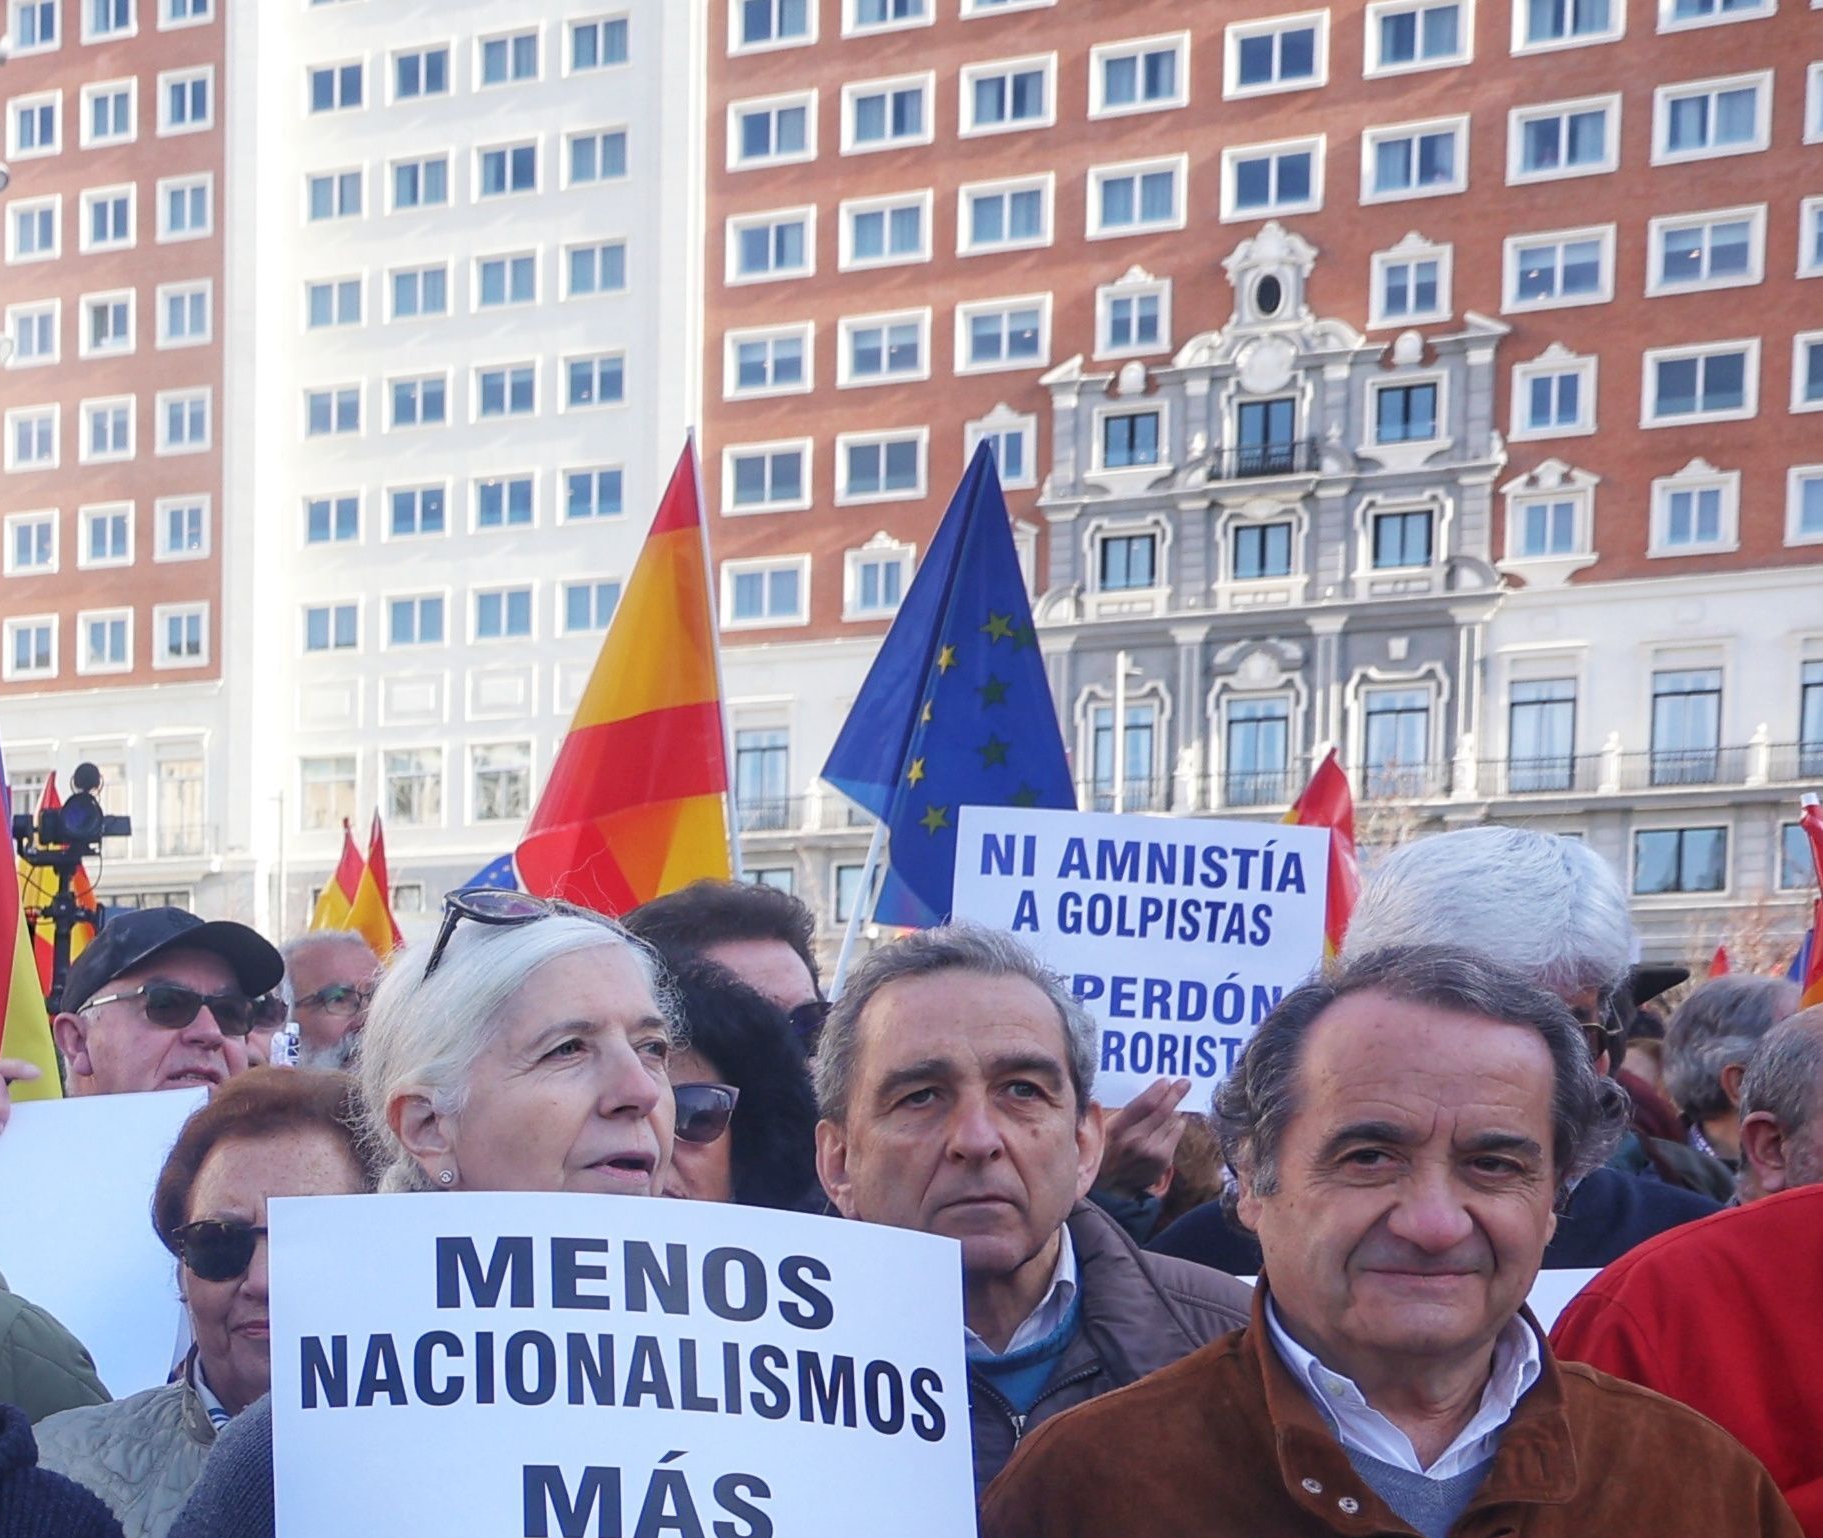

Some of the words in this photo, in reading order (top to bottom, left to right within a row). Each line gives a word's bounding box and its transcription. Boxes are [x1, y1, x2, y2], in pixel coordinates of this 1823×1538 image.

[980, 833, 1036, 877] NI
[1057, 839, 1306, 894] AMNISTÍA
[1012, 890, 1040, 932] A
[1058, 891, 1272, 946] GOLPISTAS
[1101, 1030, 1241, 1077] RORIST
[435, 1236, 834, 1330] MENOS
[300, 1330, 947, 1442] NACIONALISMOS
